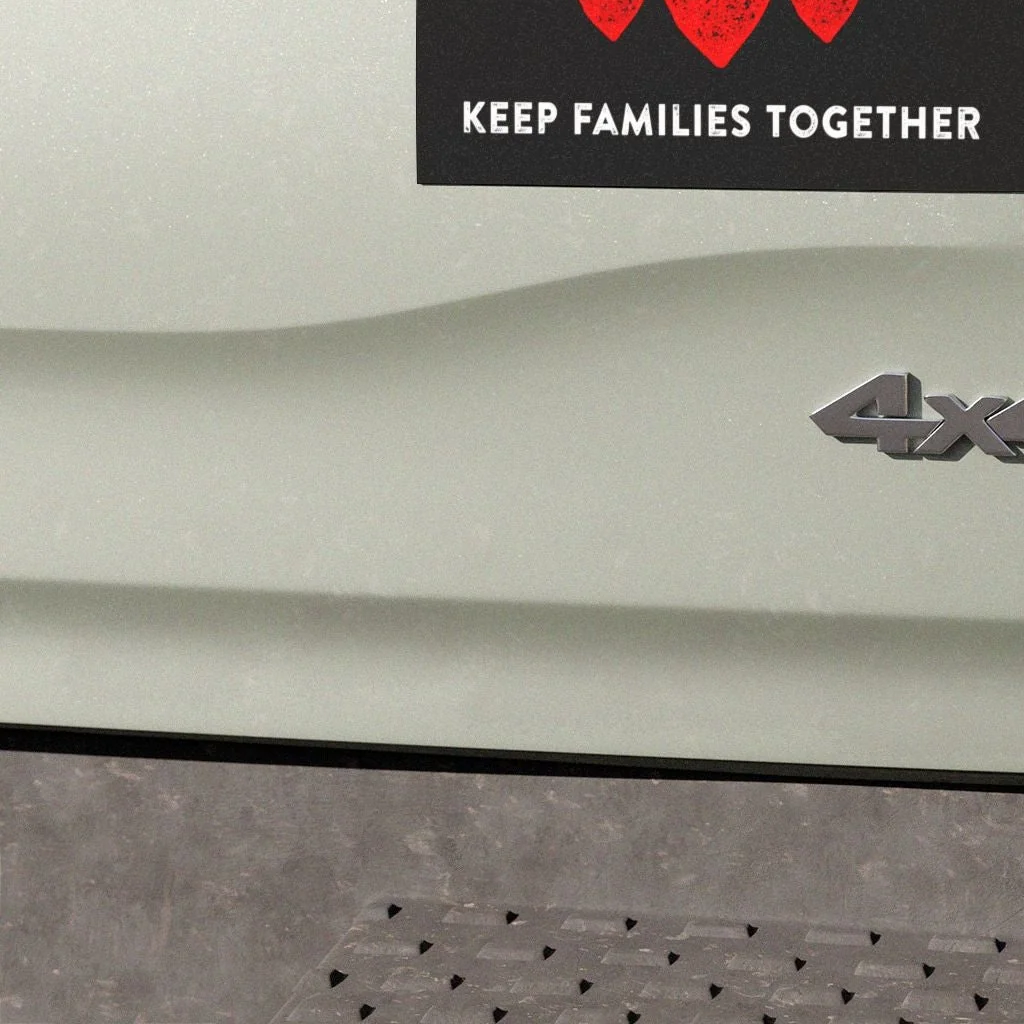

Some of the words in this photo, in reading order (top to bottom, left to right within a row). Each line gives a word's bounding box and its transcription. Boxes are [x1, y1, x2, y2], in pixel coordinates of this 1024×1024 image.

[462, 100, 558, 135] KEEP
[573, 102, 751, 138] FAMILIES
[765, 104, 982, 140] TOGETHER
